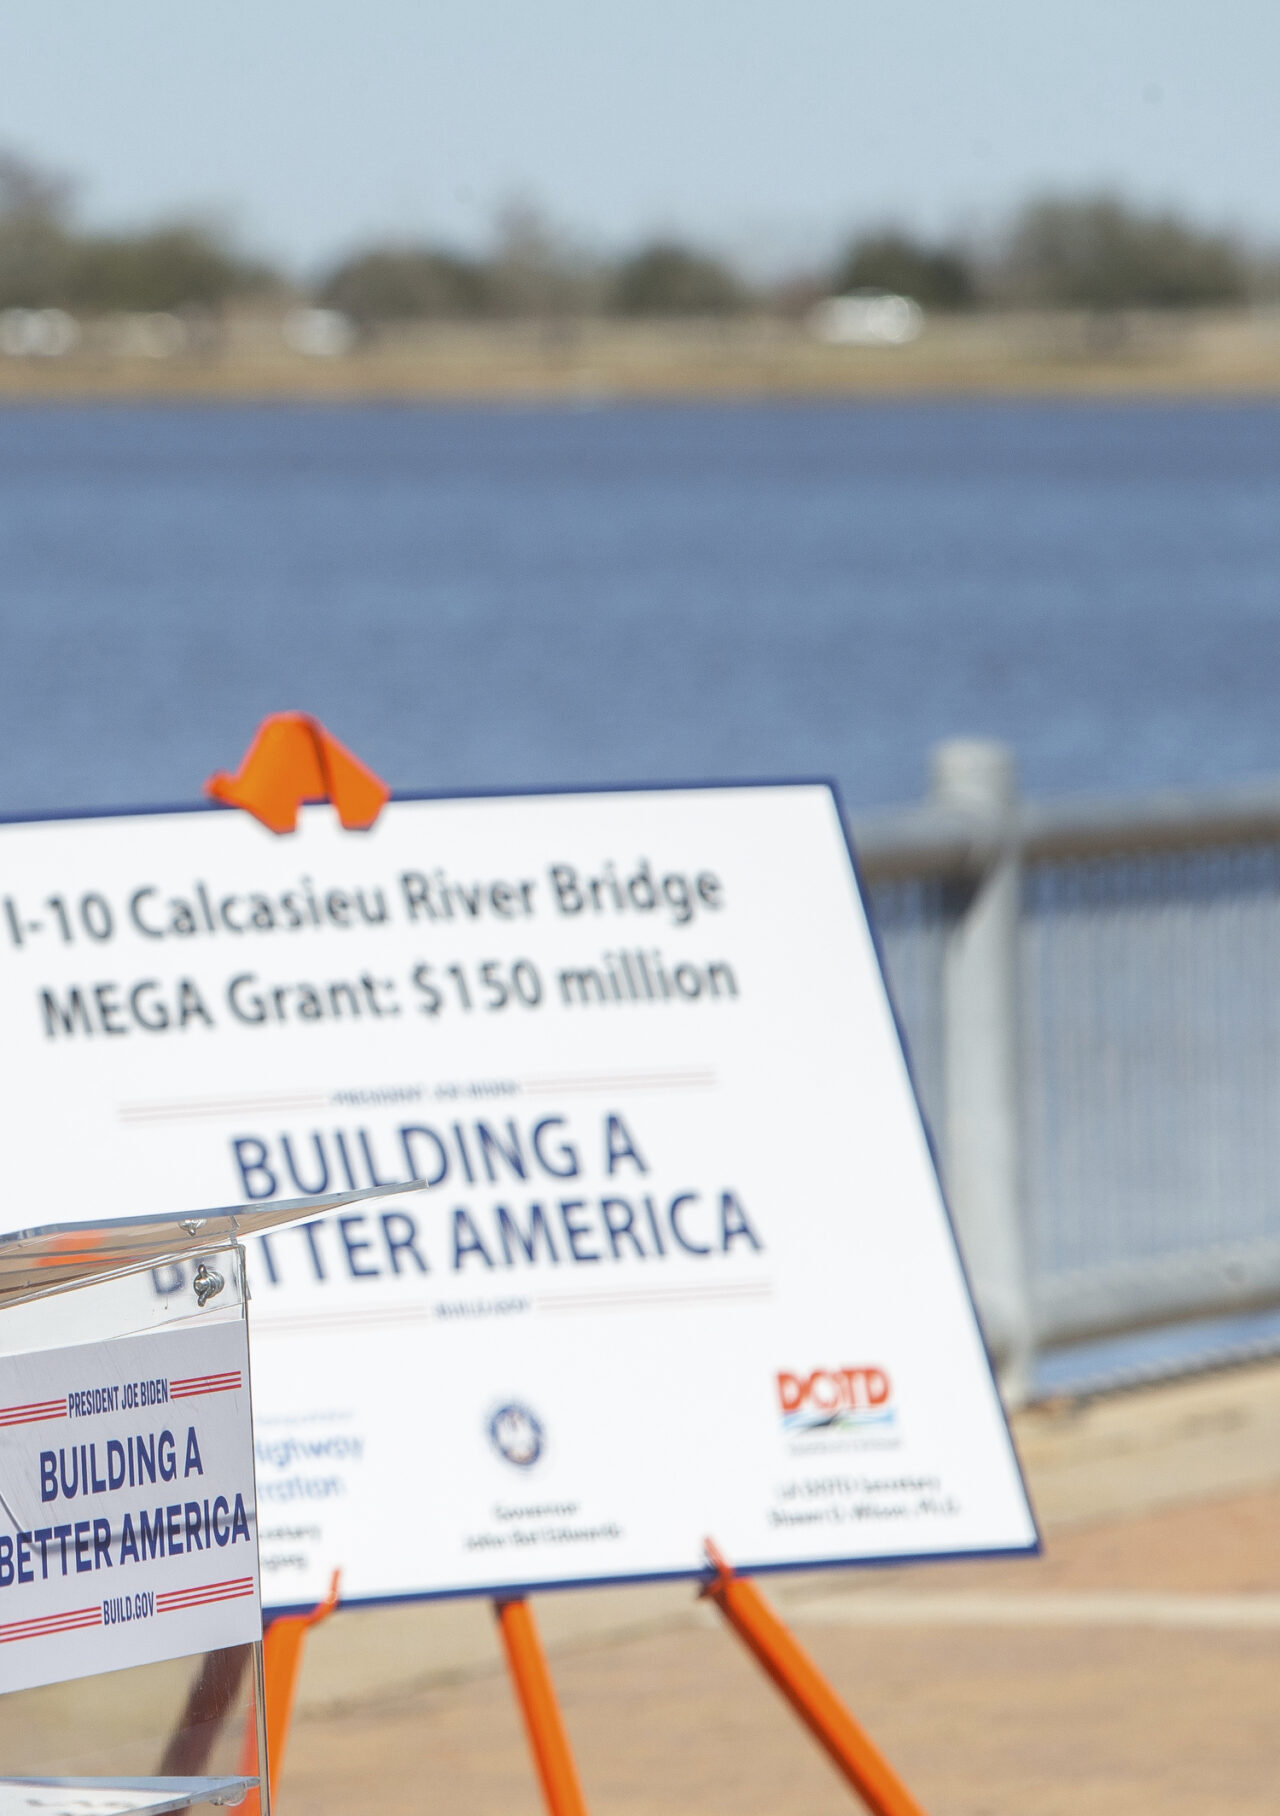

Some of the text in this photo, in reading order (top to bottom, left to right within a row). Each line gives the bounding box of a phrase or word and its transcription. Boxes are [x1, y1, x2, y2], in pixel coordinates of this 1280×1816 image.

[3, 858, 726, 949] I-10 Calcasieu River Bridge
[39, 948, 740, 1041] MEGA Grant: $150 million
[231, 1111, 649, 1200] BUILDING A
[449, 1188, 764, 1274] AMERICA
[69, 1379, 168, 1418] PRESIDENT JOE BIDEN
[40, 1426, 203, 1503] BUILDING A
[119, 1493, 250, 1565] AMERICA
[103, 1592, 154, 1626] BUILD.GOV
